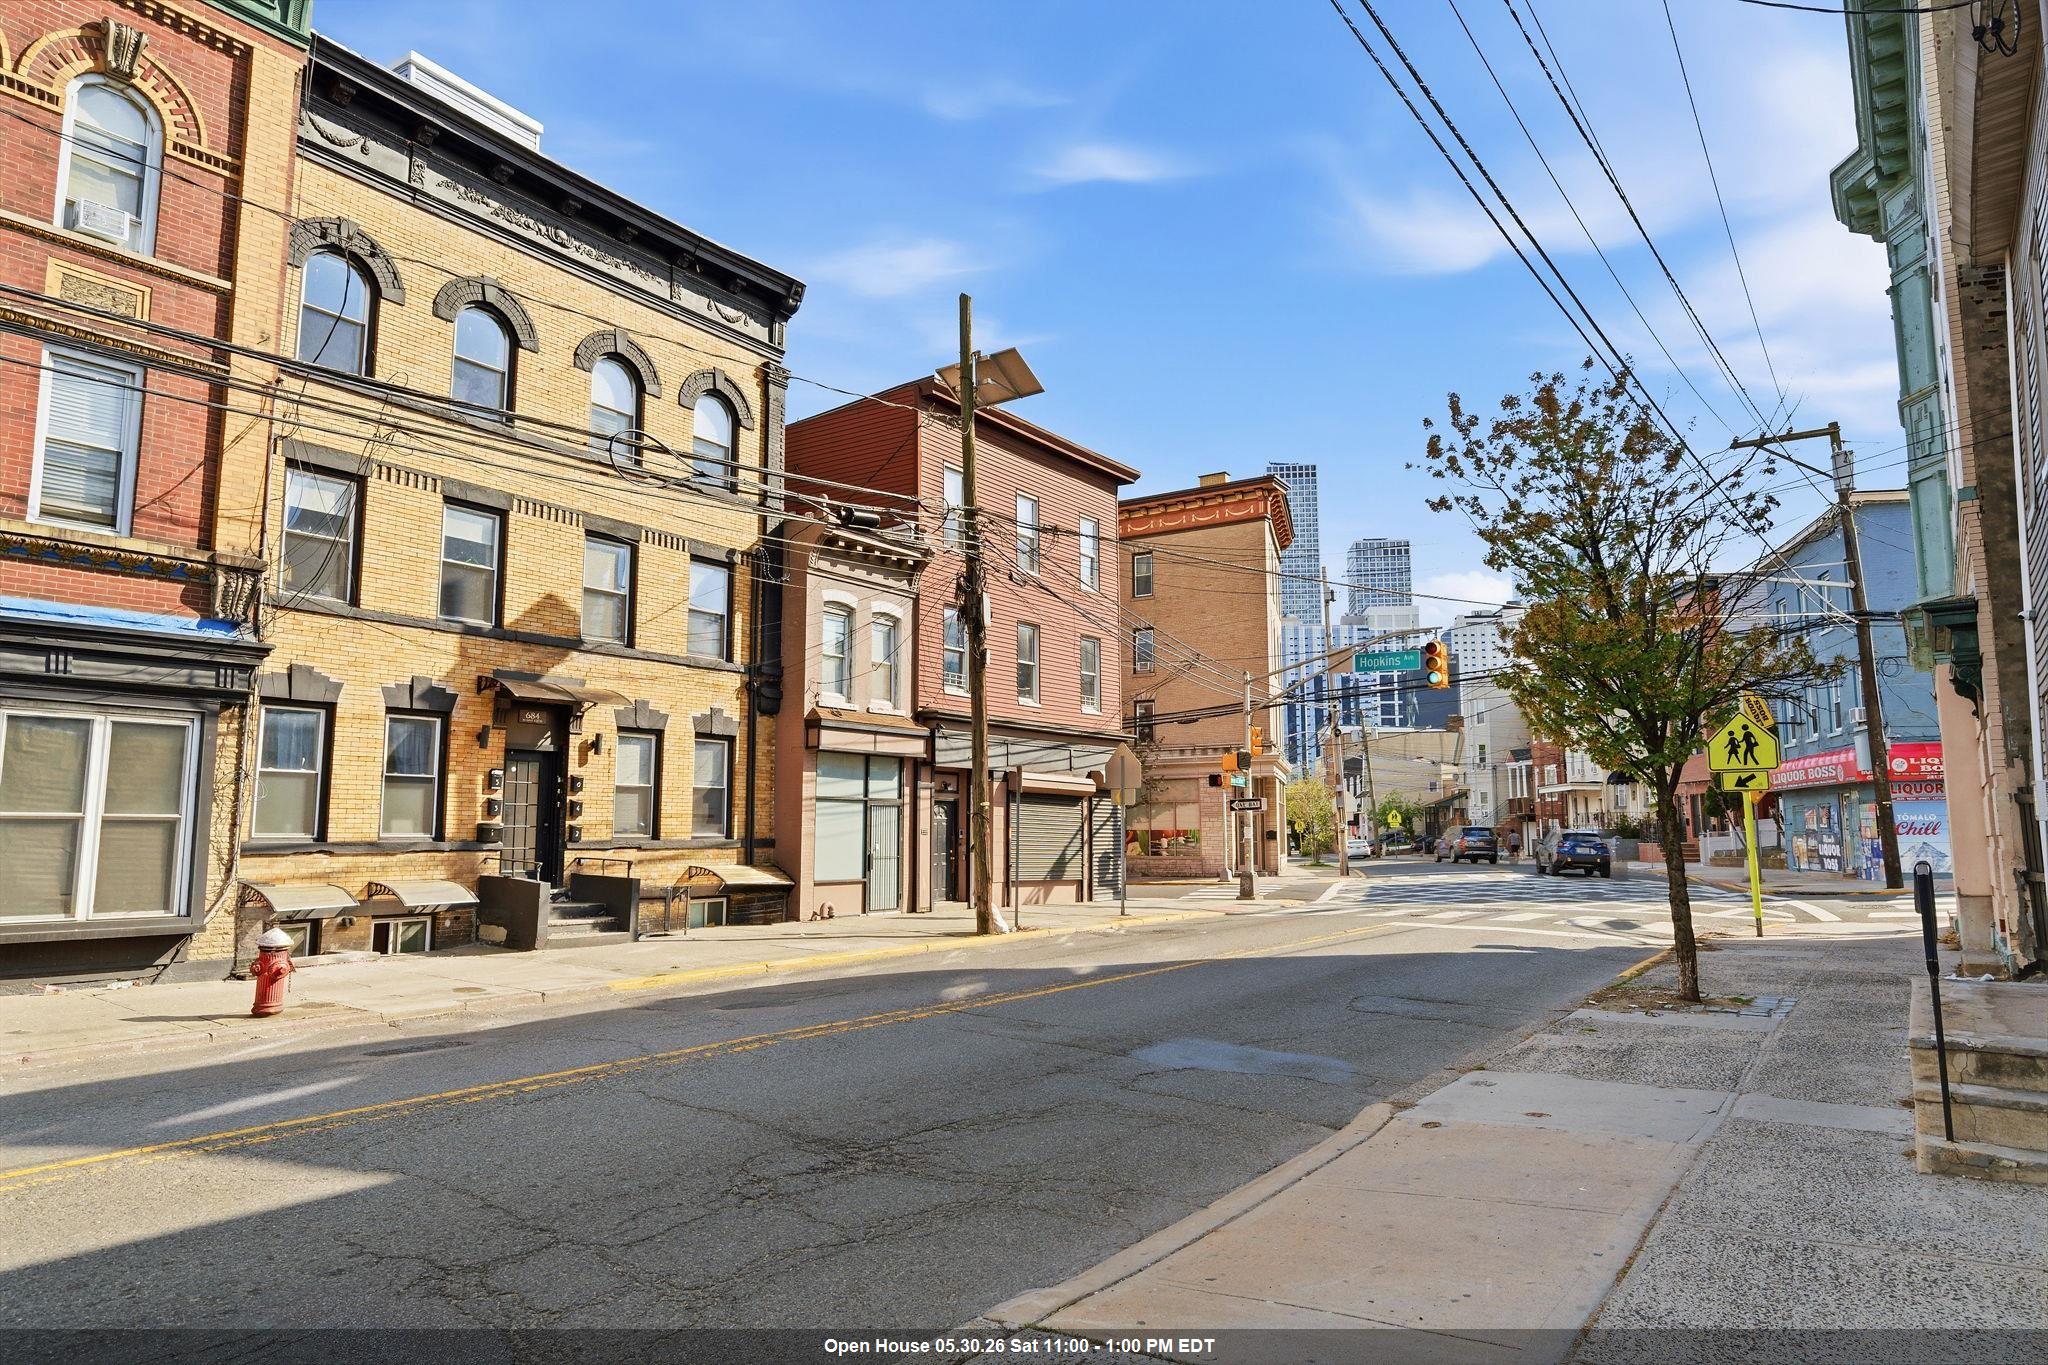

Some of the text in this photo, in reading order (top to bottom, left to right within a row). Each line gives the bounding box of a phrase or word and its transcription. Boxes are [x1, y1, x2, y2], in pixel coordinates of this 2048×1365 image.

[1360, 656, 1401, 669] Hopkins
[525, 711, 540, 720] 684
[1753, 699, 1770, 721] BOSS
[1773, 769, 1807, 784] LIQUOR
[1808, 765, 1837, 779] BOSS
[1890, 783, 1945, 795] LIQUOR
[1896, 821, 1942, 836] Chill
